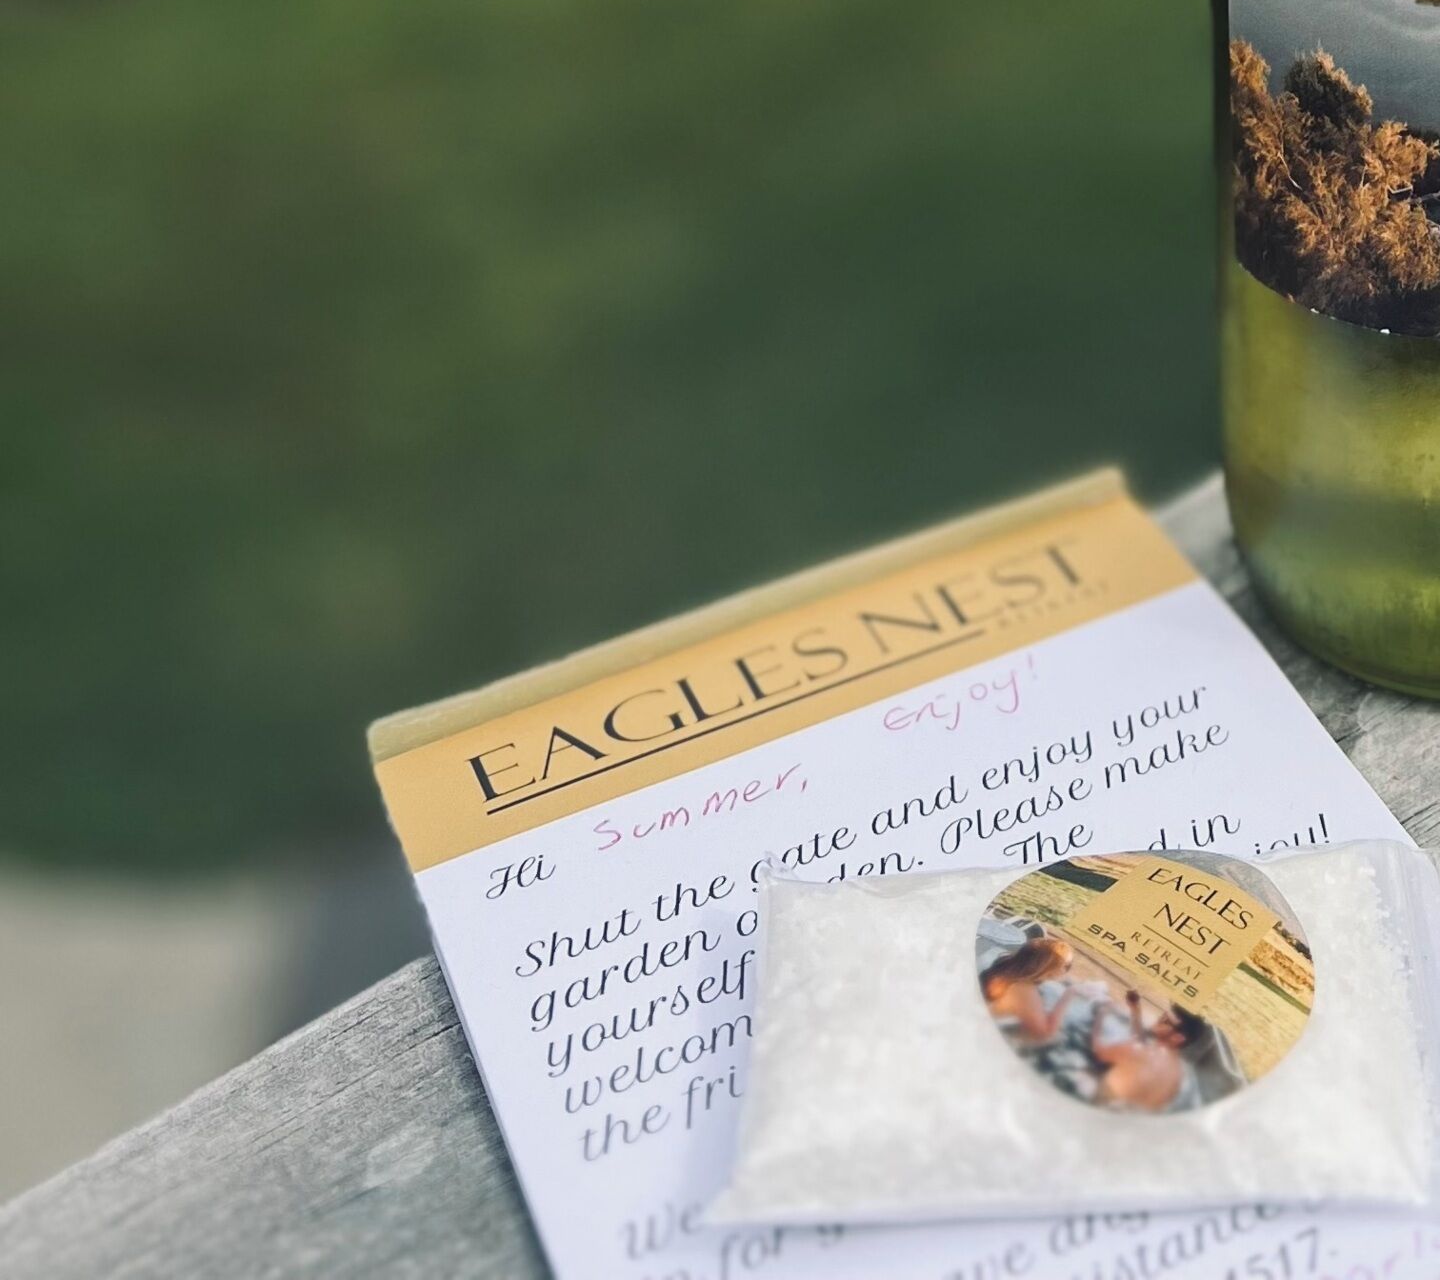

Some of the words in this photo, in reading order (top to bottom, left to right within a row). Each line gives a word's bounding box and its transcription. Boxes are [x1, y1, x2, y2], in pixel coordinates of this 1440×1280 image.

[465, 626, 849, 802] EAGLES
[858, 534, 1080, 654] NEST
[514, 909, 642, 977] Shut
[651, 874, 736, 921] the
[871, 774, 968, 837] and
[981, 729, 1093, 793] enjoy
[1112, 685, 1209, 748] your
[593, 762, 808, 851] Summer,
[485, 854, 556, 900] Hi
[530, 929, 722, 1032] garden
[939, 773, 1092, 854] Please
[1104, 722, 1230, 789] make
[1147, 868, 1254, 930] EAGLES
[547, 949, 756, 1078] yourself
[1003, 821, 1094, 866] The
[564, 1014, 753, 1114] welcom
[1190, 813, 1242, 848] in
[1087, 923, 1127, 953] SPA
[1135, 952, 1199, 999] SALTS
[1131, 930, 1203, 981] RETREAT
[1153, 902, 1231, 955] NEST
[580, 1104, 672, 1162] the
